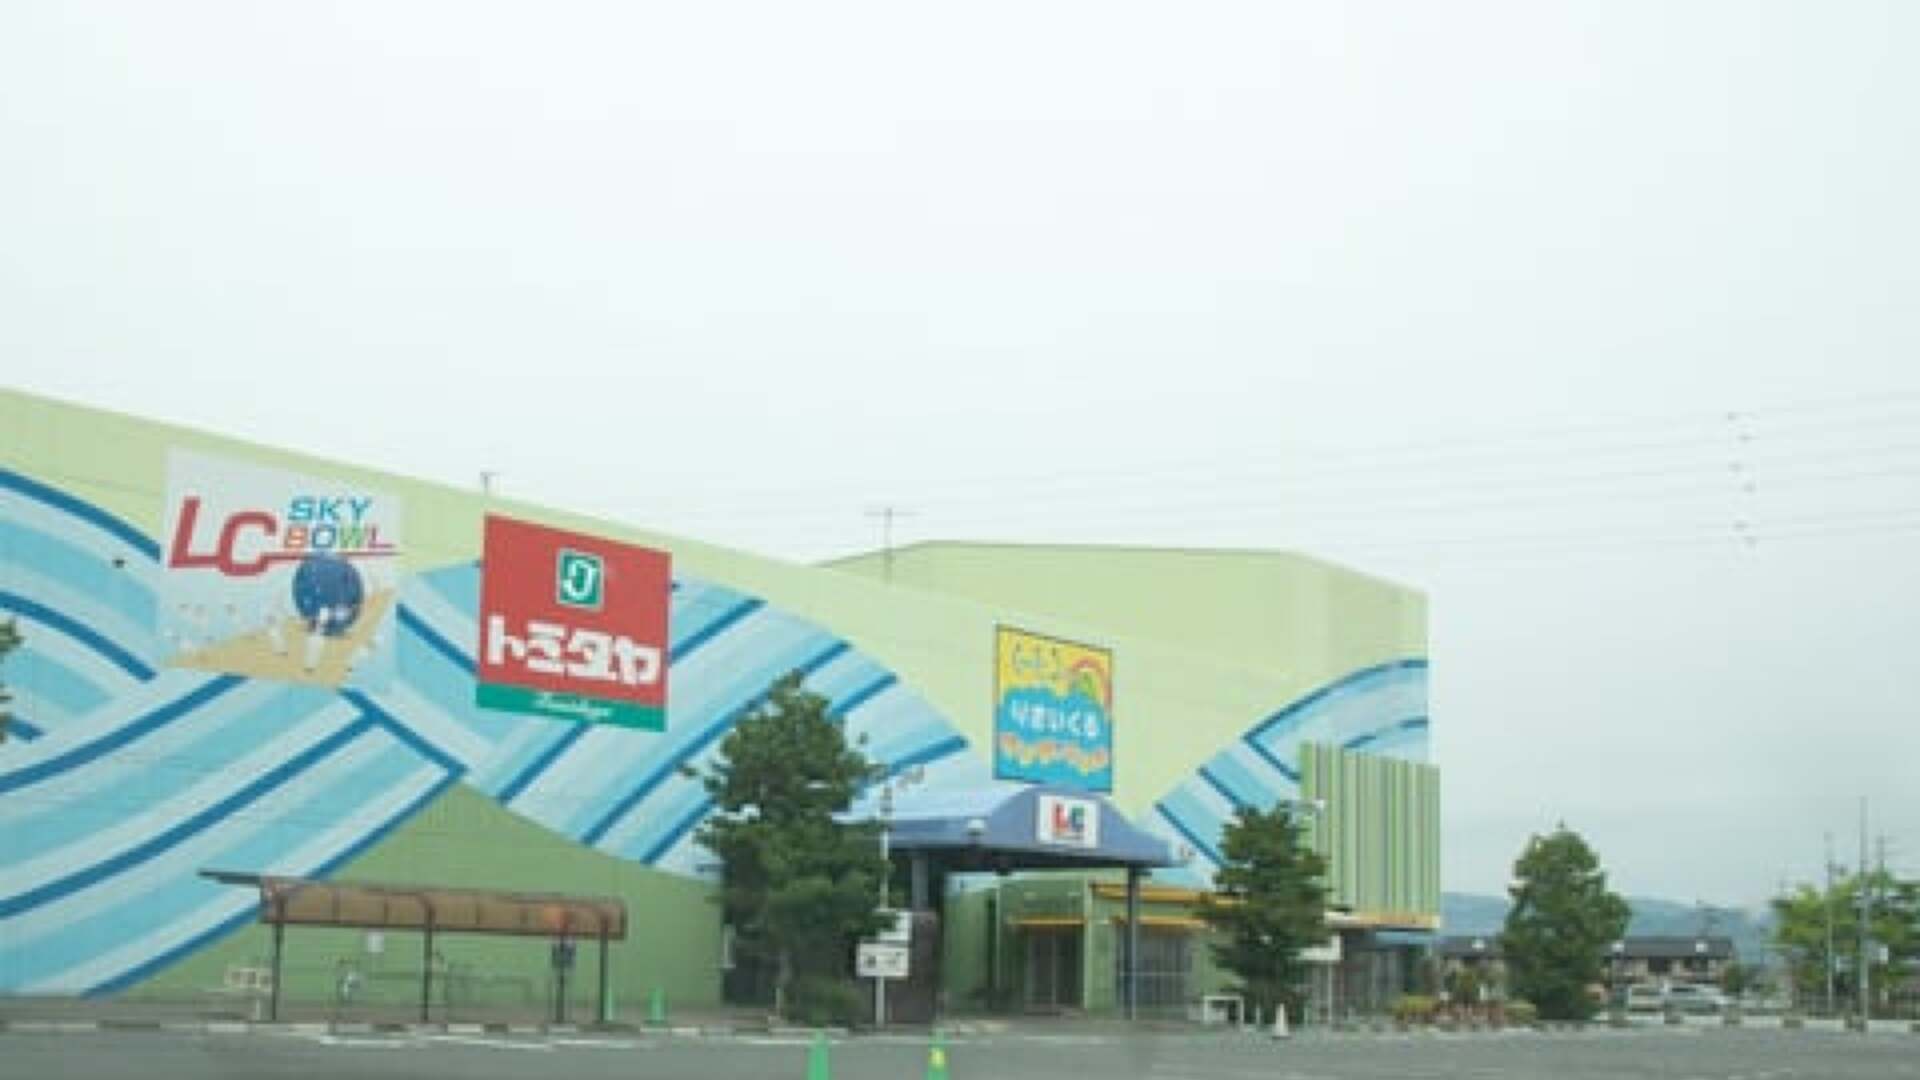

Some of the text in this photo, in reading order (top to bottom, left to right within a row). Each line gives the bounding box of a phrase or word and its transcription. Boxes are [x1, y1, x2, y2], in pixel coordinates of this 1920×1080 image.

[288, 496, 372, 521] SKY
[168, 495, 278, 577] LC
[283, 523, 396, 550] BOWL
[487, 613, 662, 687] トミダヤ
